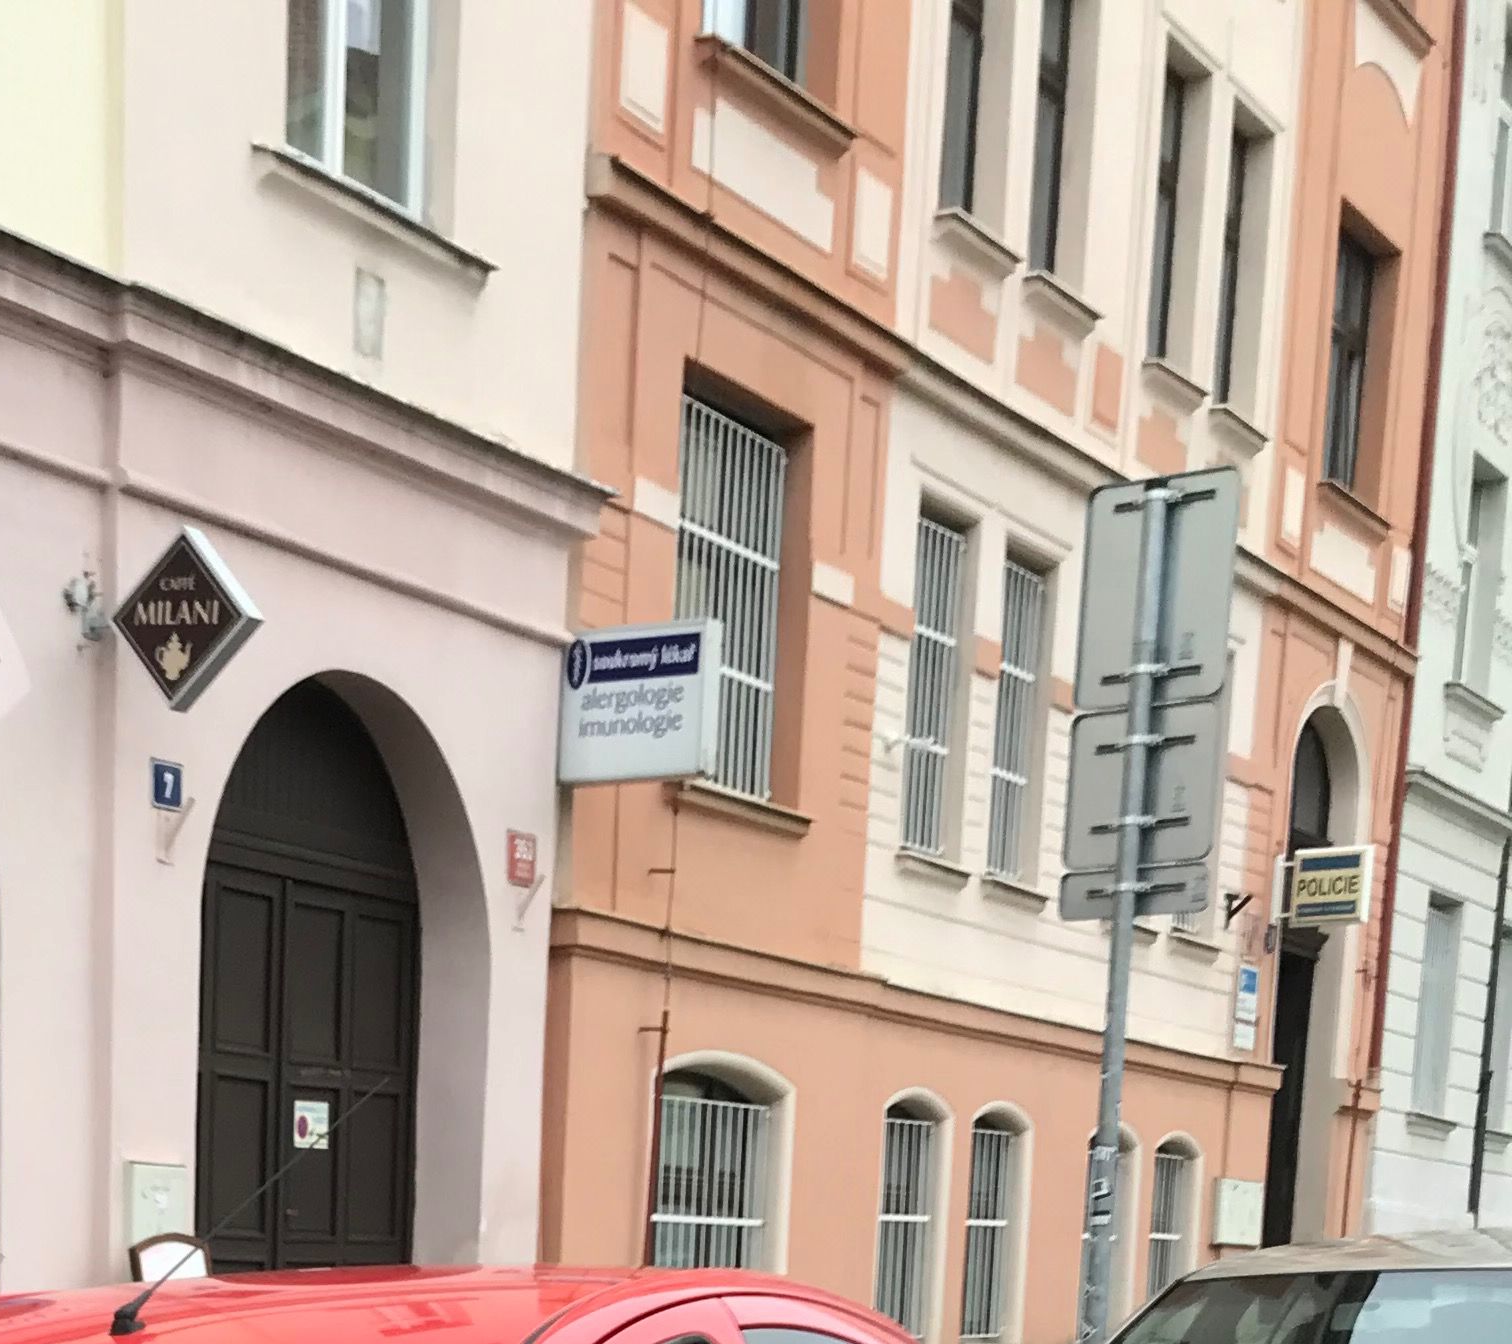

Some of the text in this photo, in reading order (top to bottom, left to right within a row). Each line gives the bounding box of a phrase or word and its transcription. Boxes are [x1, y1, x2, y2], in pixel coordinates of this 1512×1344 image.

[134, 600, 220, 625] MILANI
[581, 681, 684, 714] alergologie
[578, 709, 683, 738] imunologie
[1296, 875, 1360, 897] POLICIE
